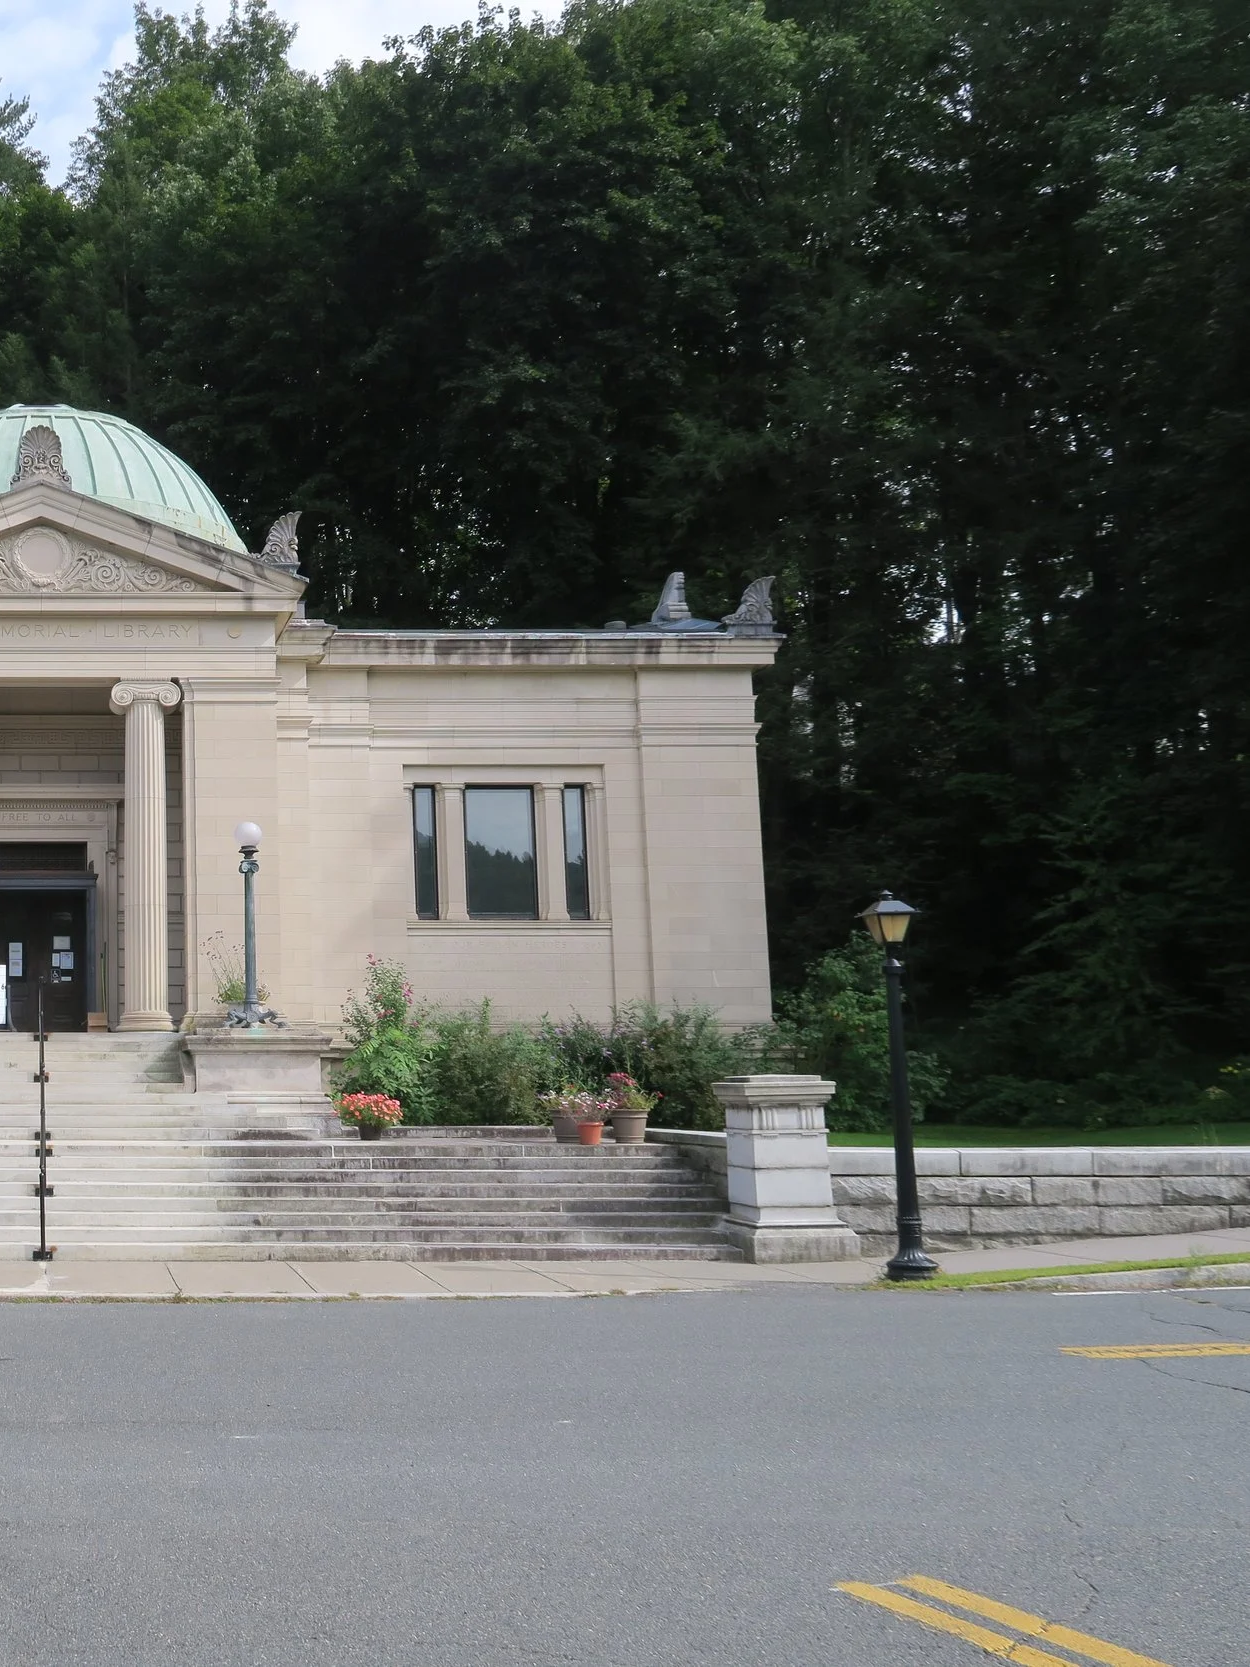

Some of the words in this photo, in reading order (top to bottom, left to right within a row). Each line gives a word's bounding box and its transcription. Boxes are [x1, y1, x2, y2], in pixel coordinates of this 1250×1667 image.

[103, 624, 193, 639] LIBRARY
[2, 812, 28, 821] FREE
[36, 812, 51, 821] TO
[57, 812, 76, 821] ALL
